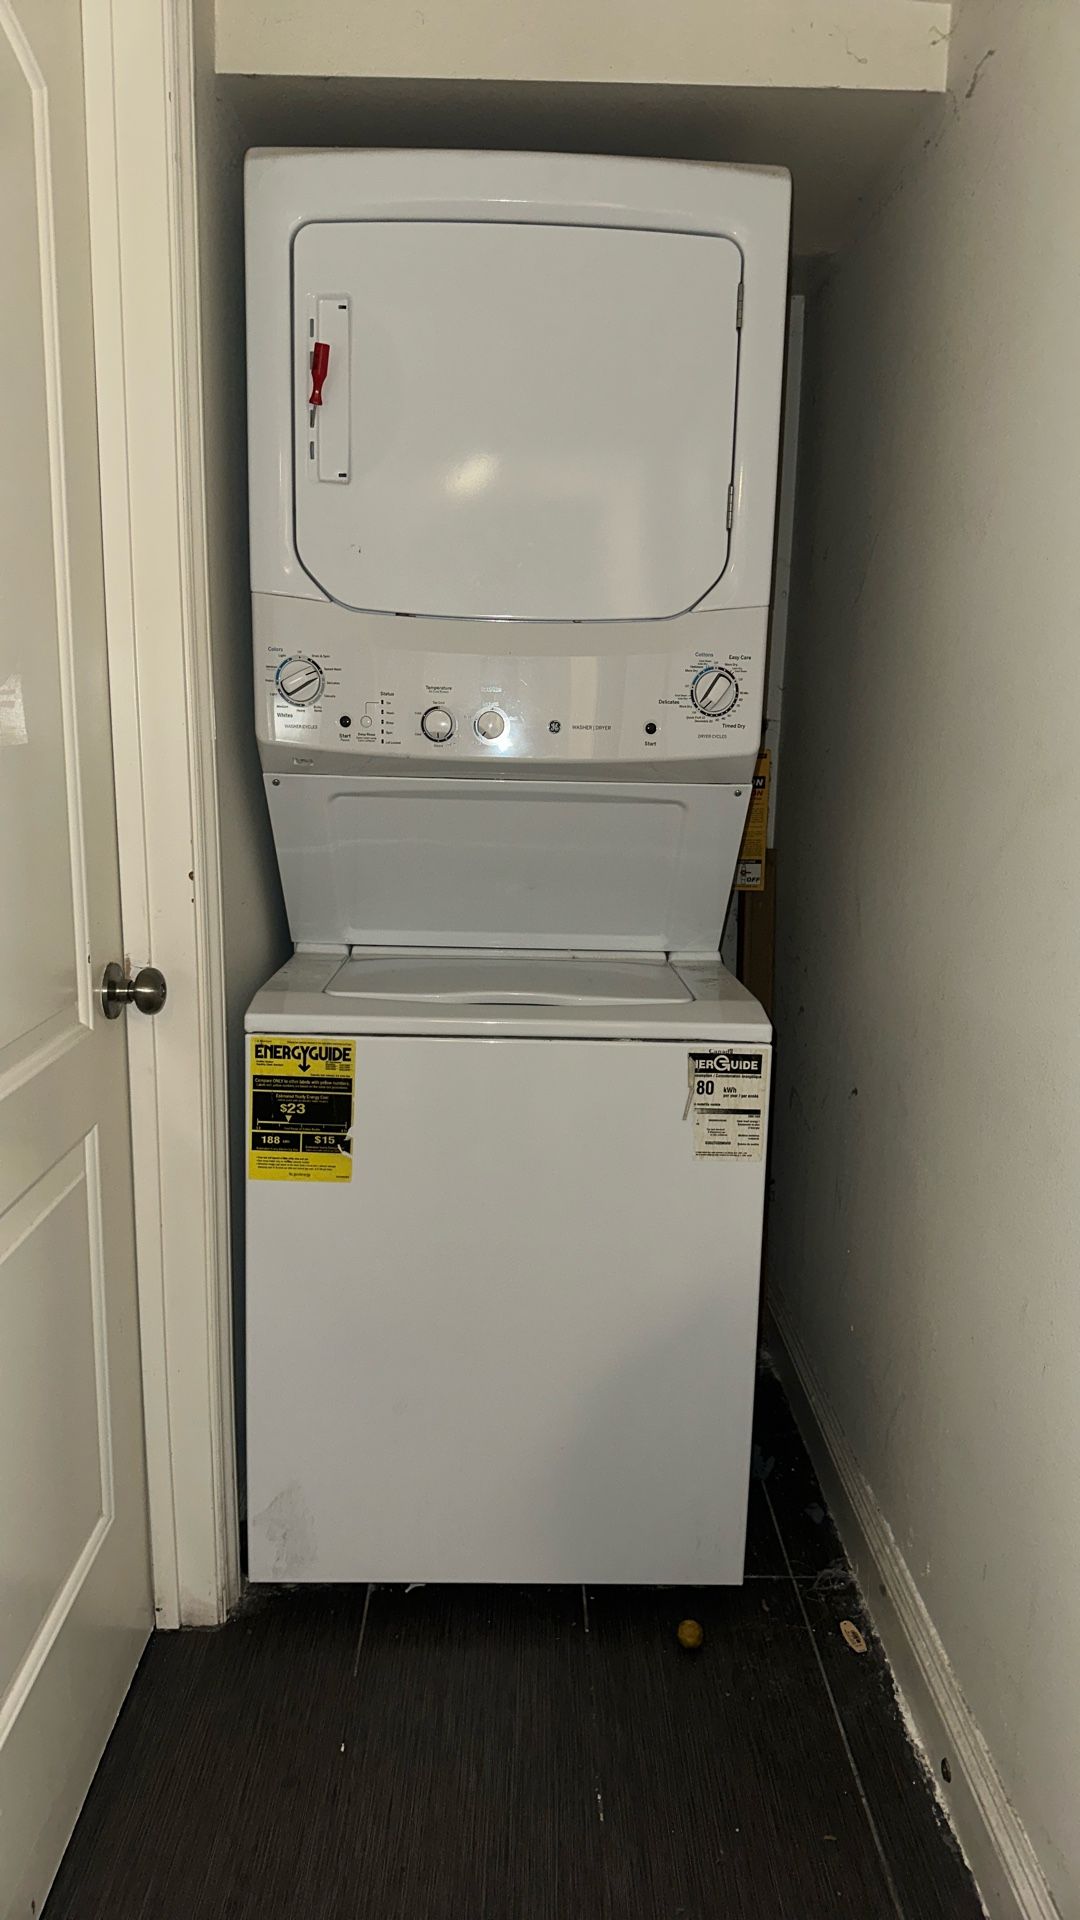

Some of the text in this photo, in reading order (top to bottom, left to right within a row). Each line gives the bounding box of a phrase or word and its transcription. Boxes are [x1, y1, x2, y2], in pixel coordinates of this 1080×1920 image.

[255, 1044, 352, 1062] ENERGYGUIDE
[696, 1080, 714, 1095] 80
[280, 1103, 306, 1114] $23
[261, 1136, 280, 1144] 188
[314, 1135, 335, 1144] $15
